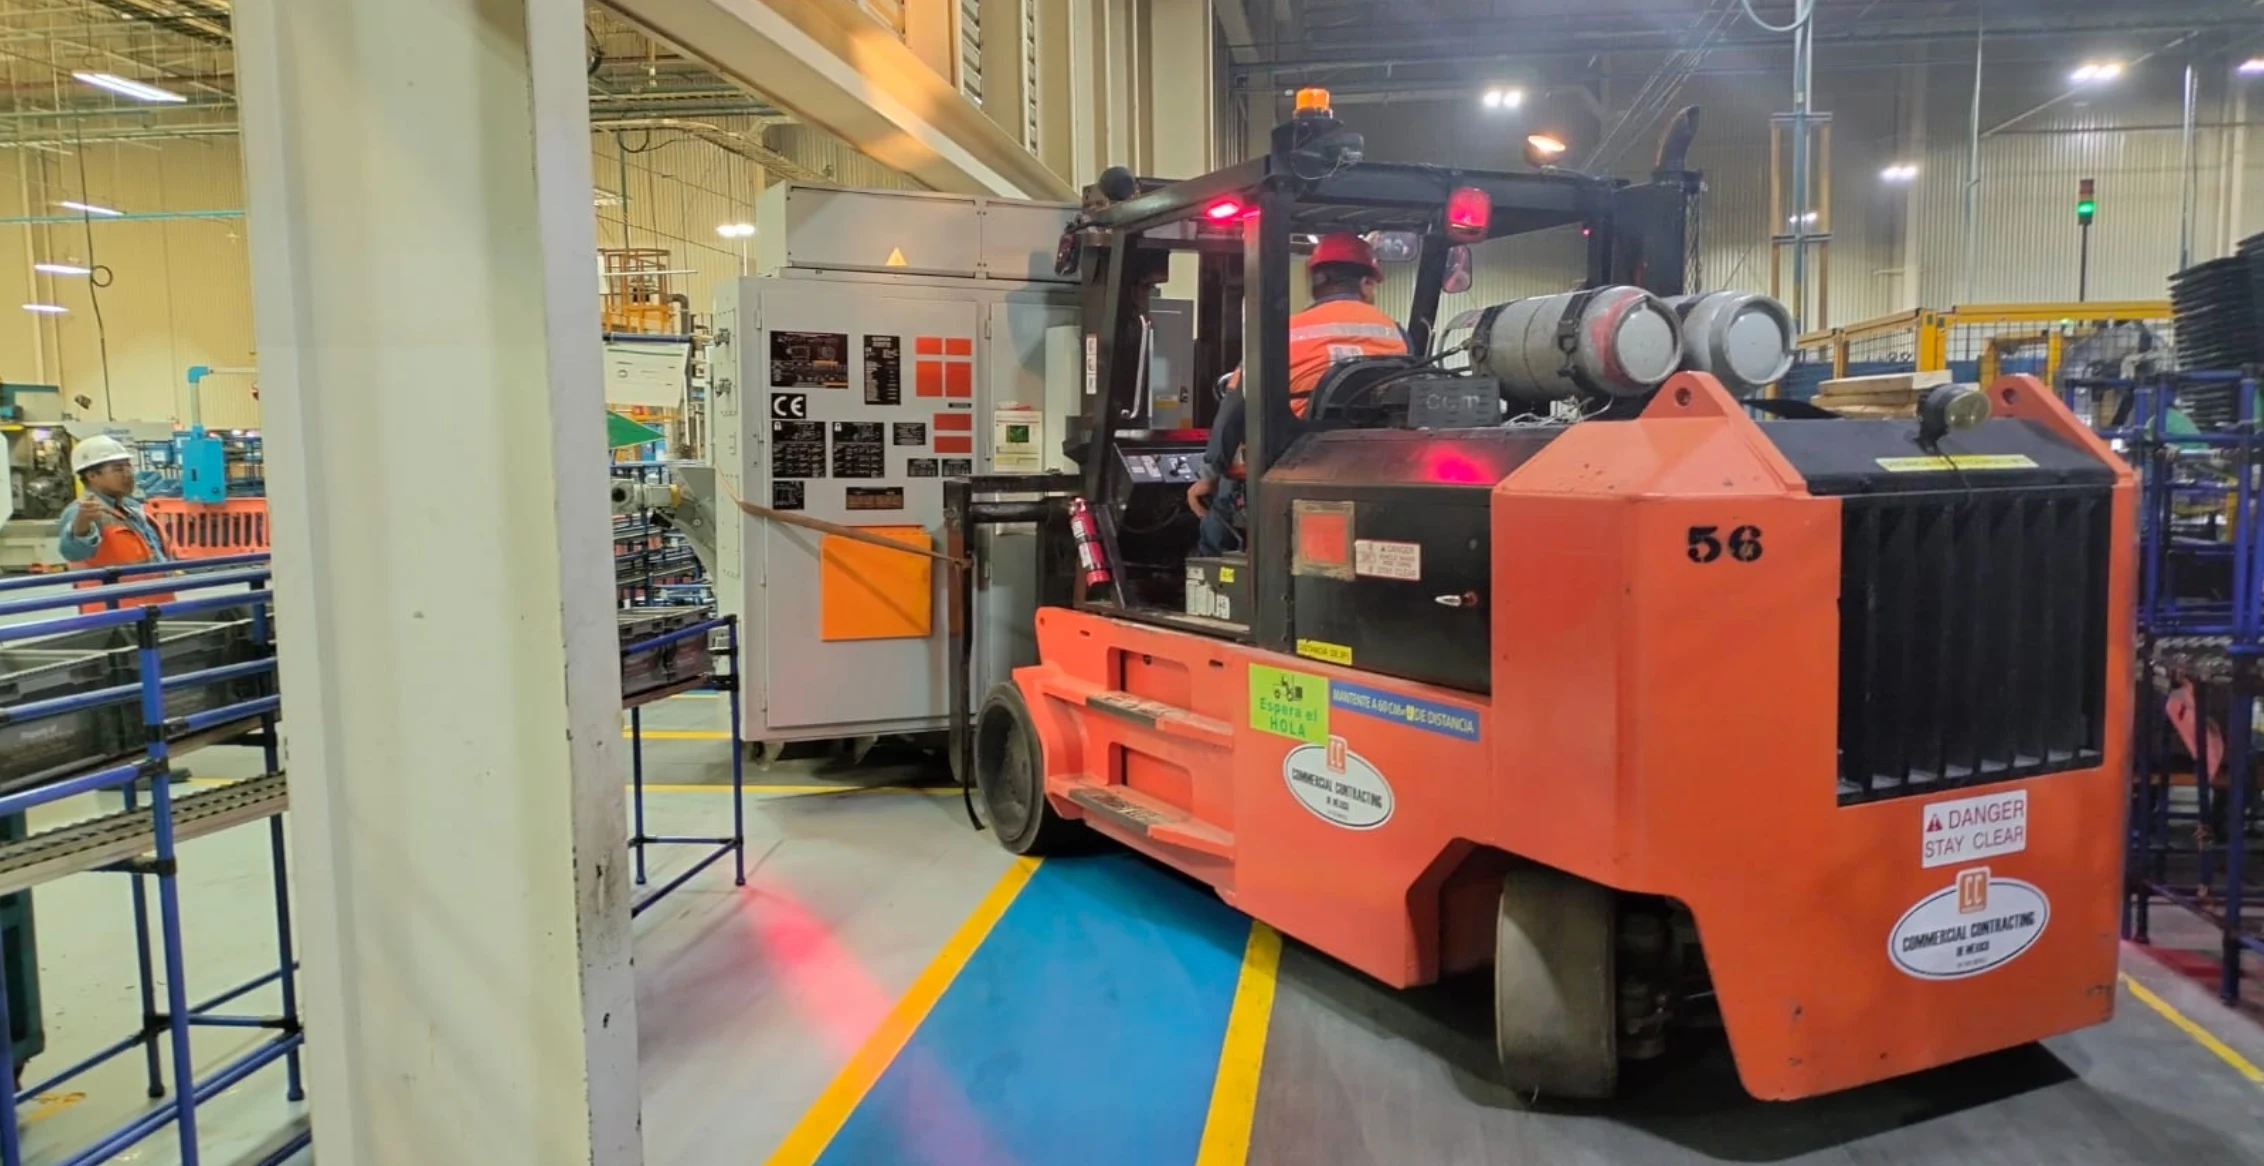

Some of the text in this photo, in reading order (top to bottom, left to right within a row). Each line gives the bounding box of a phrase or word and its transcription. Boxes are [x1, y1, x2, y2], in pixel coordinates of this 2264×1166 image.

[773, 395, 805, 417] CE
[1687, 524, 1763, 563] 56
[1260, 697, 1317, 722] Espera el
[1427, 710, 1475, 734] DISTANCIA
[1270, 716, 1306, 738] HOLA
[1291, 767, 1383, 808] COMMERCIAL CONTRACTING
[1948, 799, 2024, 829] DANGER
[1924, 826, 2023, 859] STAY CLEAR
[1903, 911, 2035, 952] COMMERCIAL CONTRACTING
